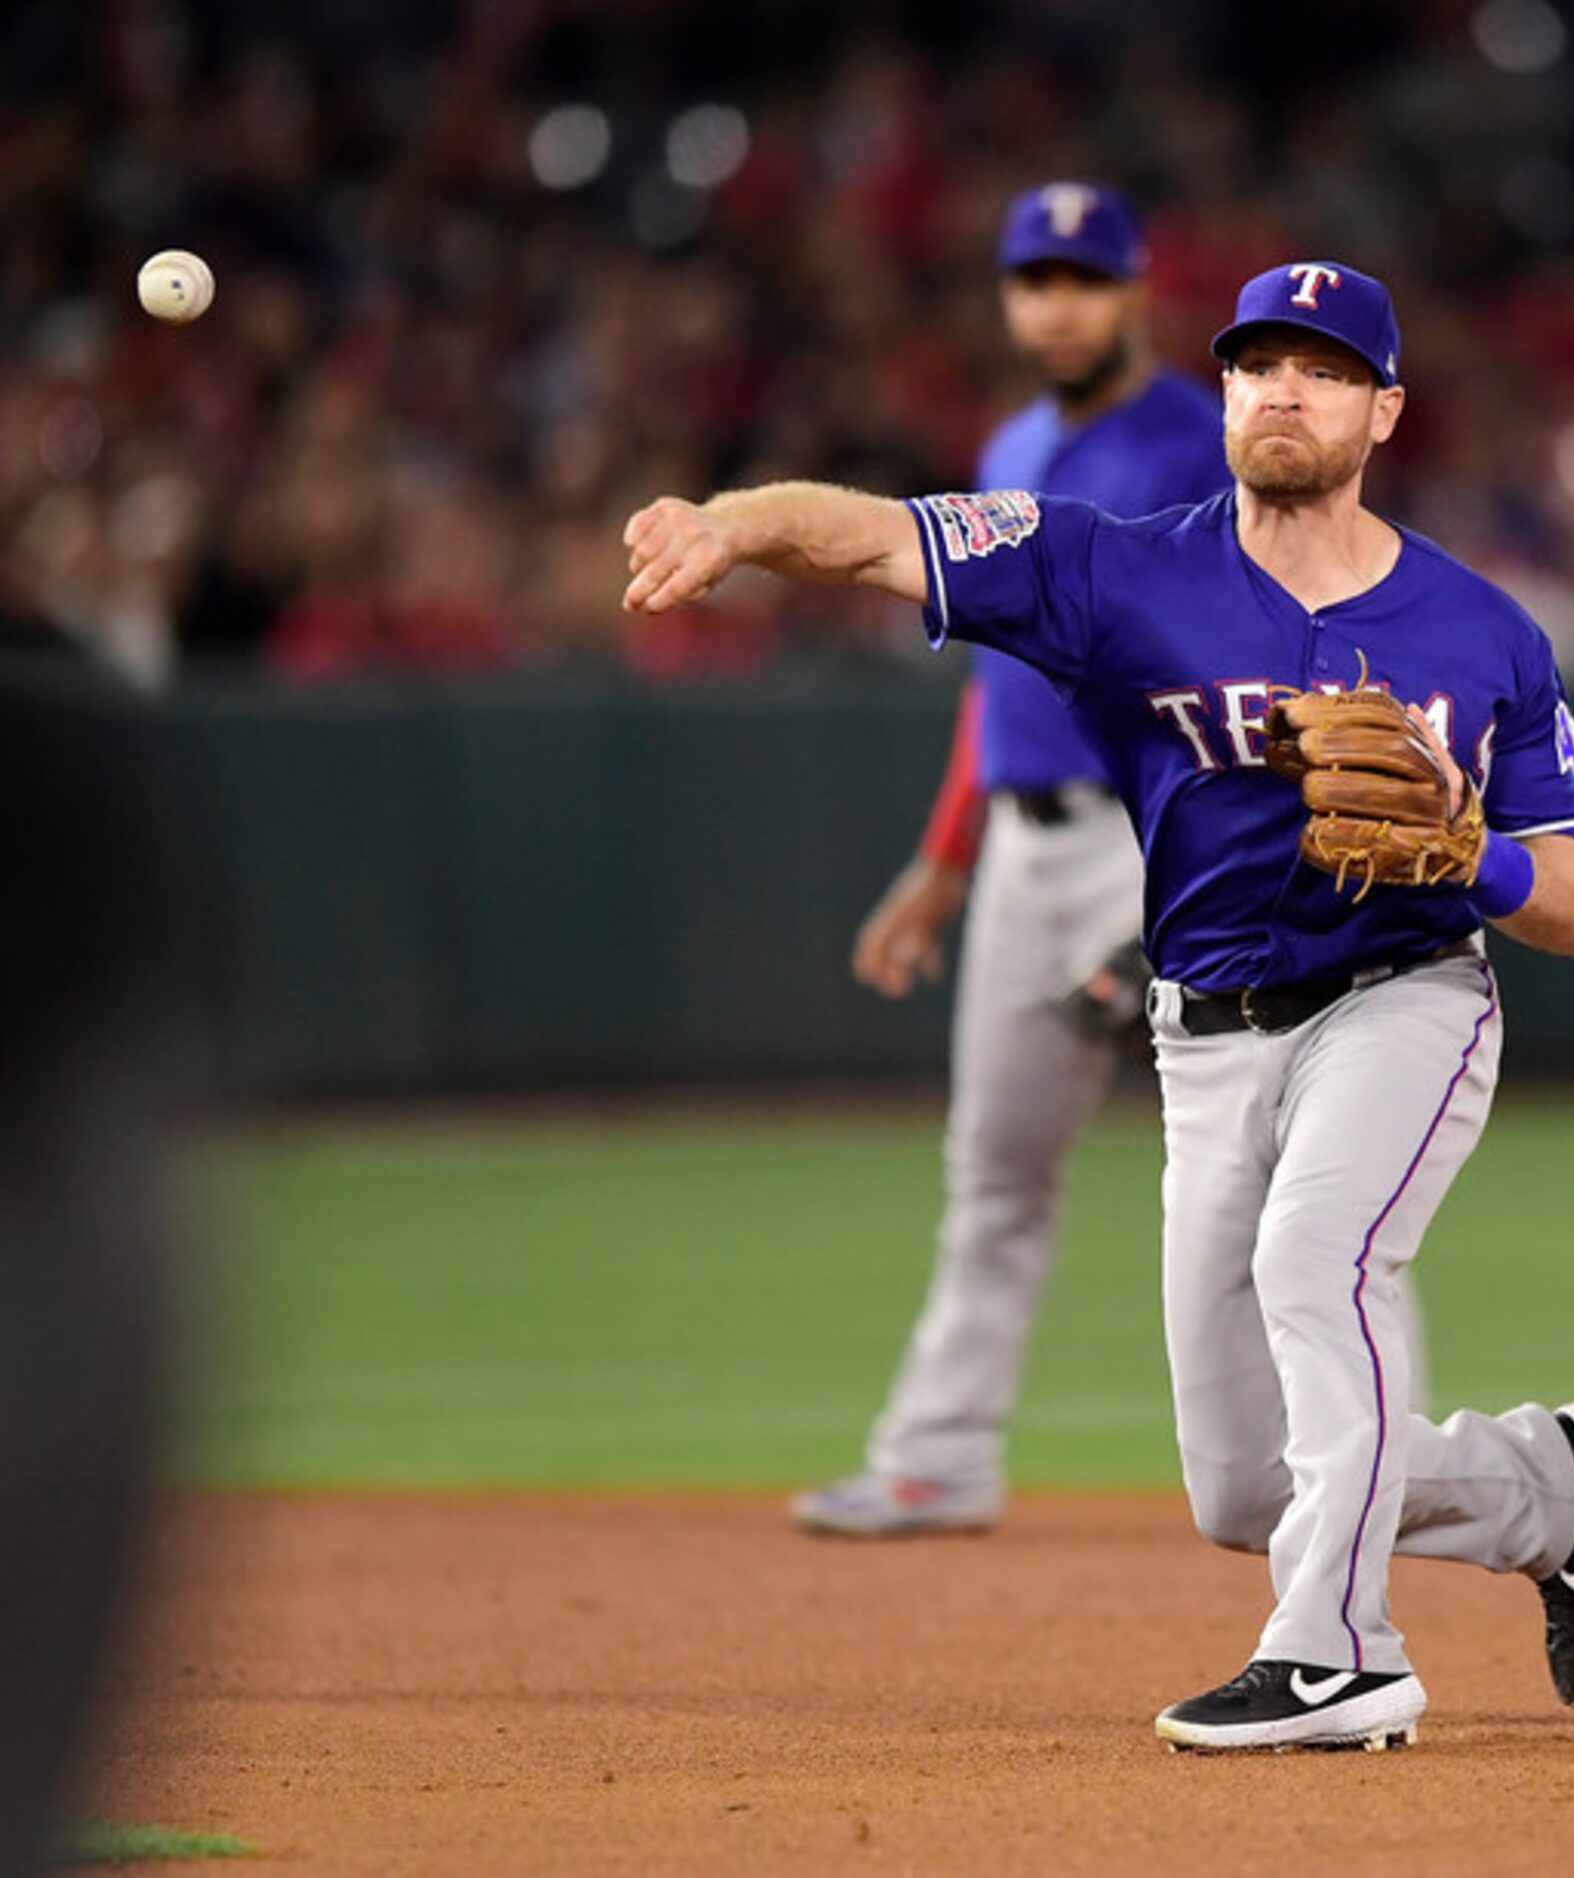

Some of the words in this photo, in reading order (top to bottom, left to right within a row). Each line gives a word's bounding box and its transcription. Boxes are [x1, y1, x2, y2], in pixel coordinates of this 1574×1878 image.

[1038, 182, 1096, 238] T
[1288, 264, 1342, 310] T
[1146, 677, 1498, 798] TEA
